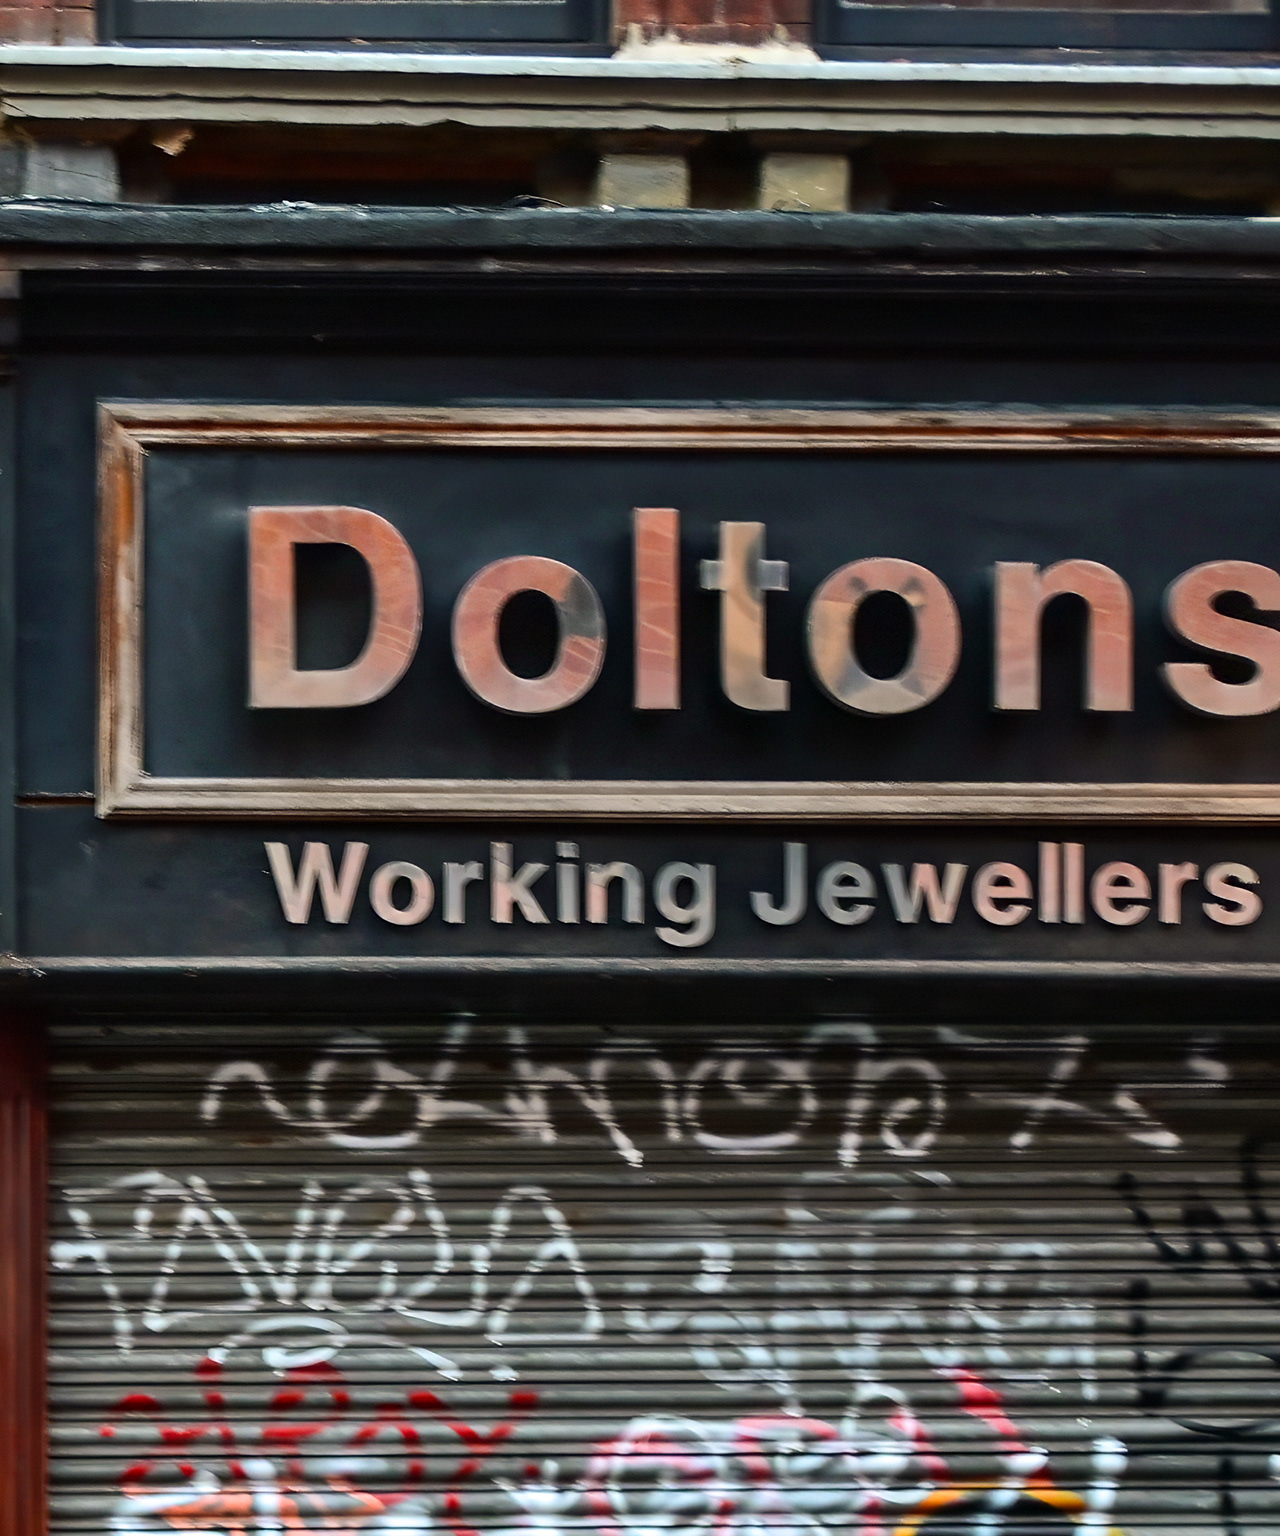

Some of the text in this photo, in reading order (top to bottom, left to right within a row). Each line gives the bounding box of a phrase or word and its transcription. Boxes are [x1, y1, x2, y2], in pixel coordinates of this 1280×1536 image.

[246, 504, 1280, 717] Doltons
[263, 839, 1262, 948] Working Jewellers
